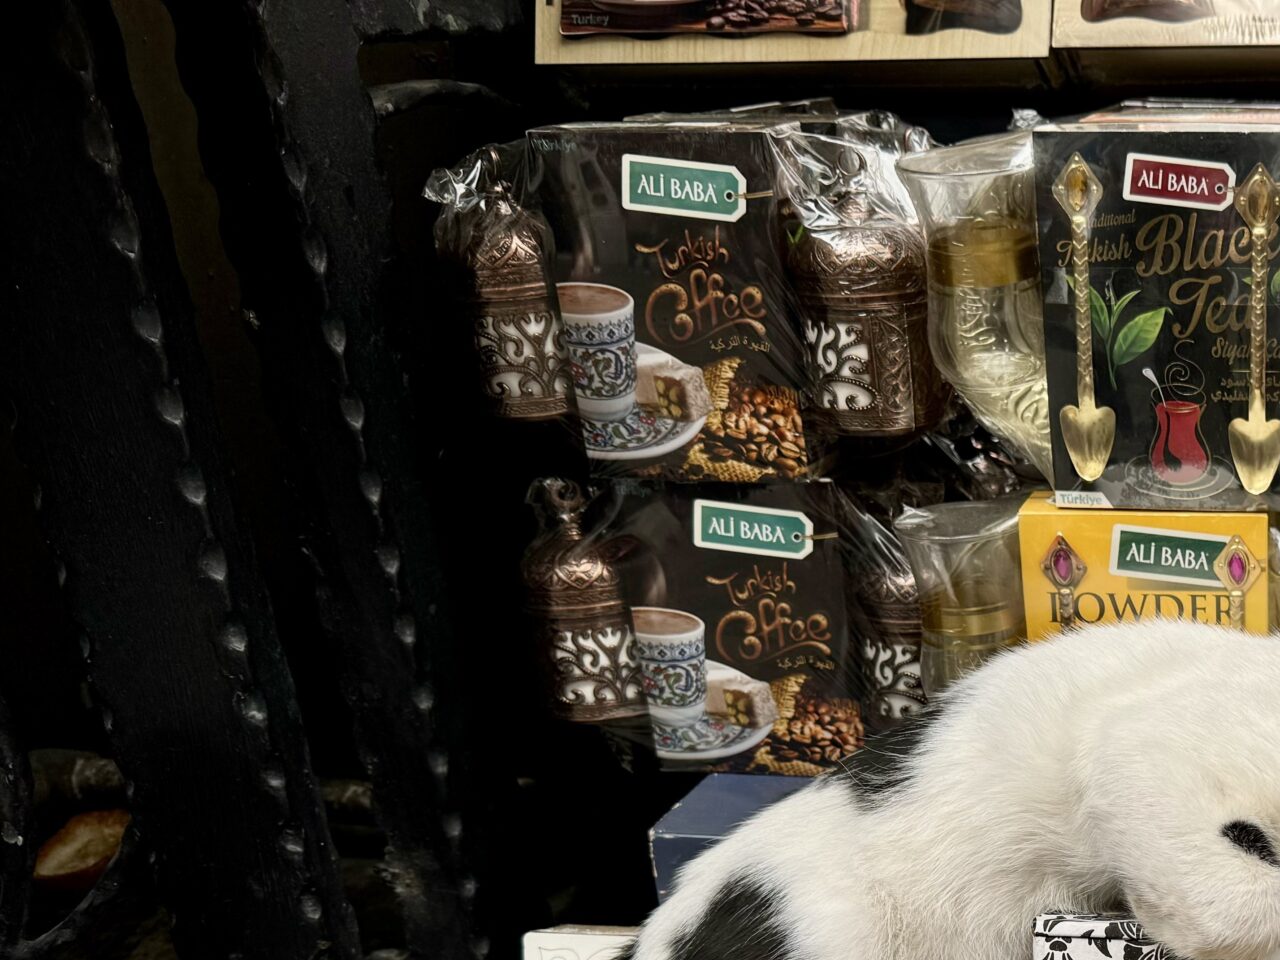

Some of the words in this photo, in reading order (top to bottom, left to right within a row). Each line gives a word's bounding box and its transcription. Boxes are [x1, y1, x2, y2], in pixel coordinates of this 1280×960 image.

[670, 178, 718, 204] BABA
[1167, 170, 1209, 197] BABA
[1088, 208, 1136, 229] aditional
[635, 224, 730, 279] Turkish
[1056, 233, 1134, 268] Tkish
[645, 268, 768, 347] Coffee
[1168, 275, 1254, 338] Tea
[1210, 337, 1251, 365] Siya
[1059, 493, 1103, 506] Türkiye
[740, 520, 785, 545] BABA
[1161, 548, 1209, 571] BABA
[705, 561, 797, 607] Turkish
[715, 598, 832, 663] Coffee
